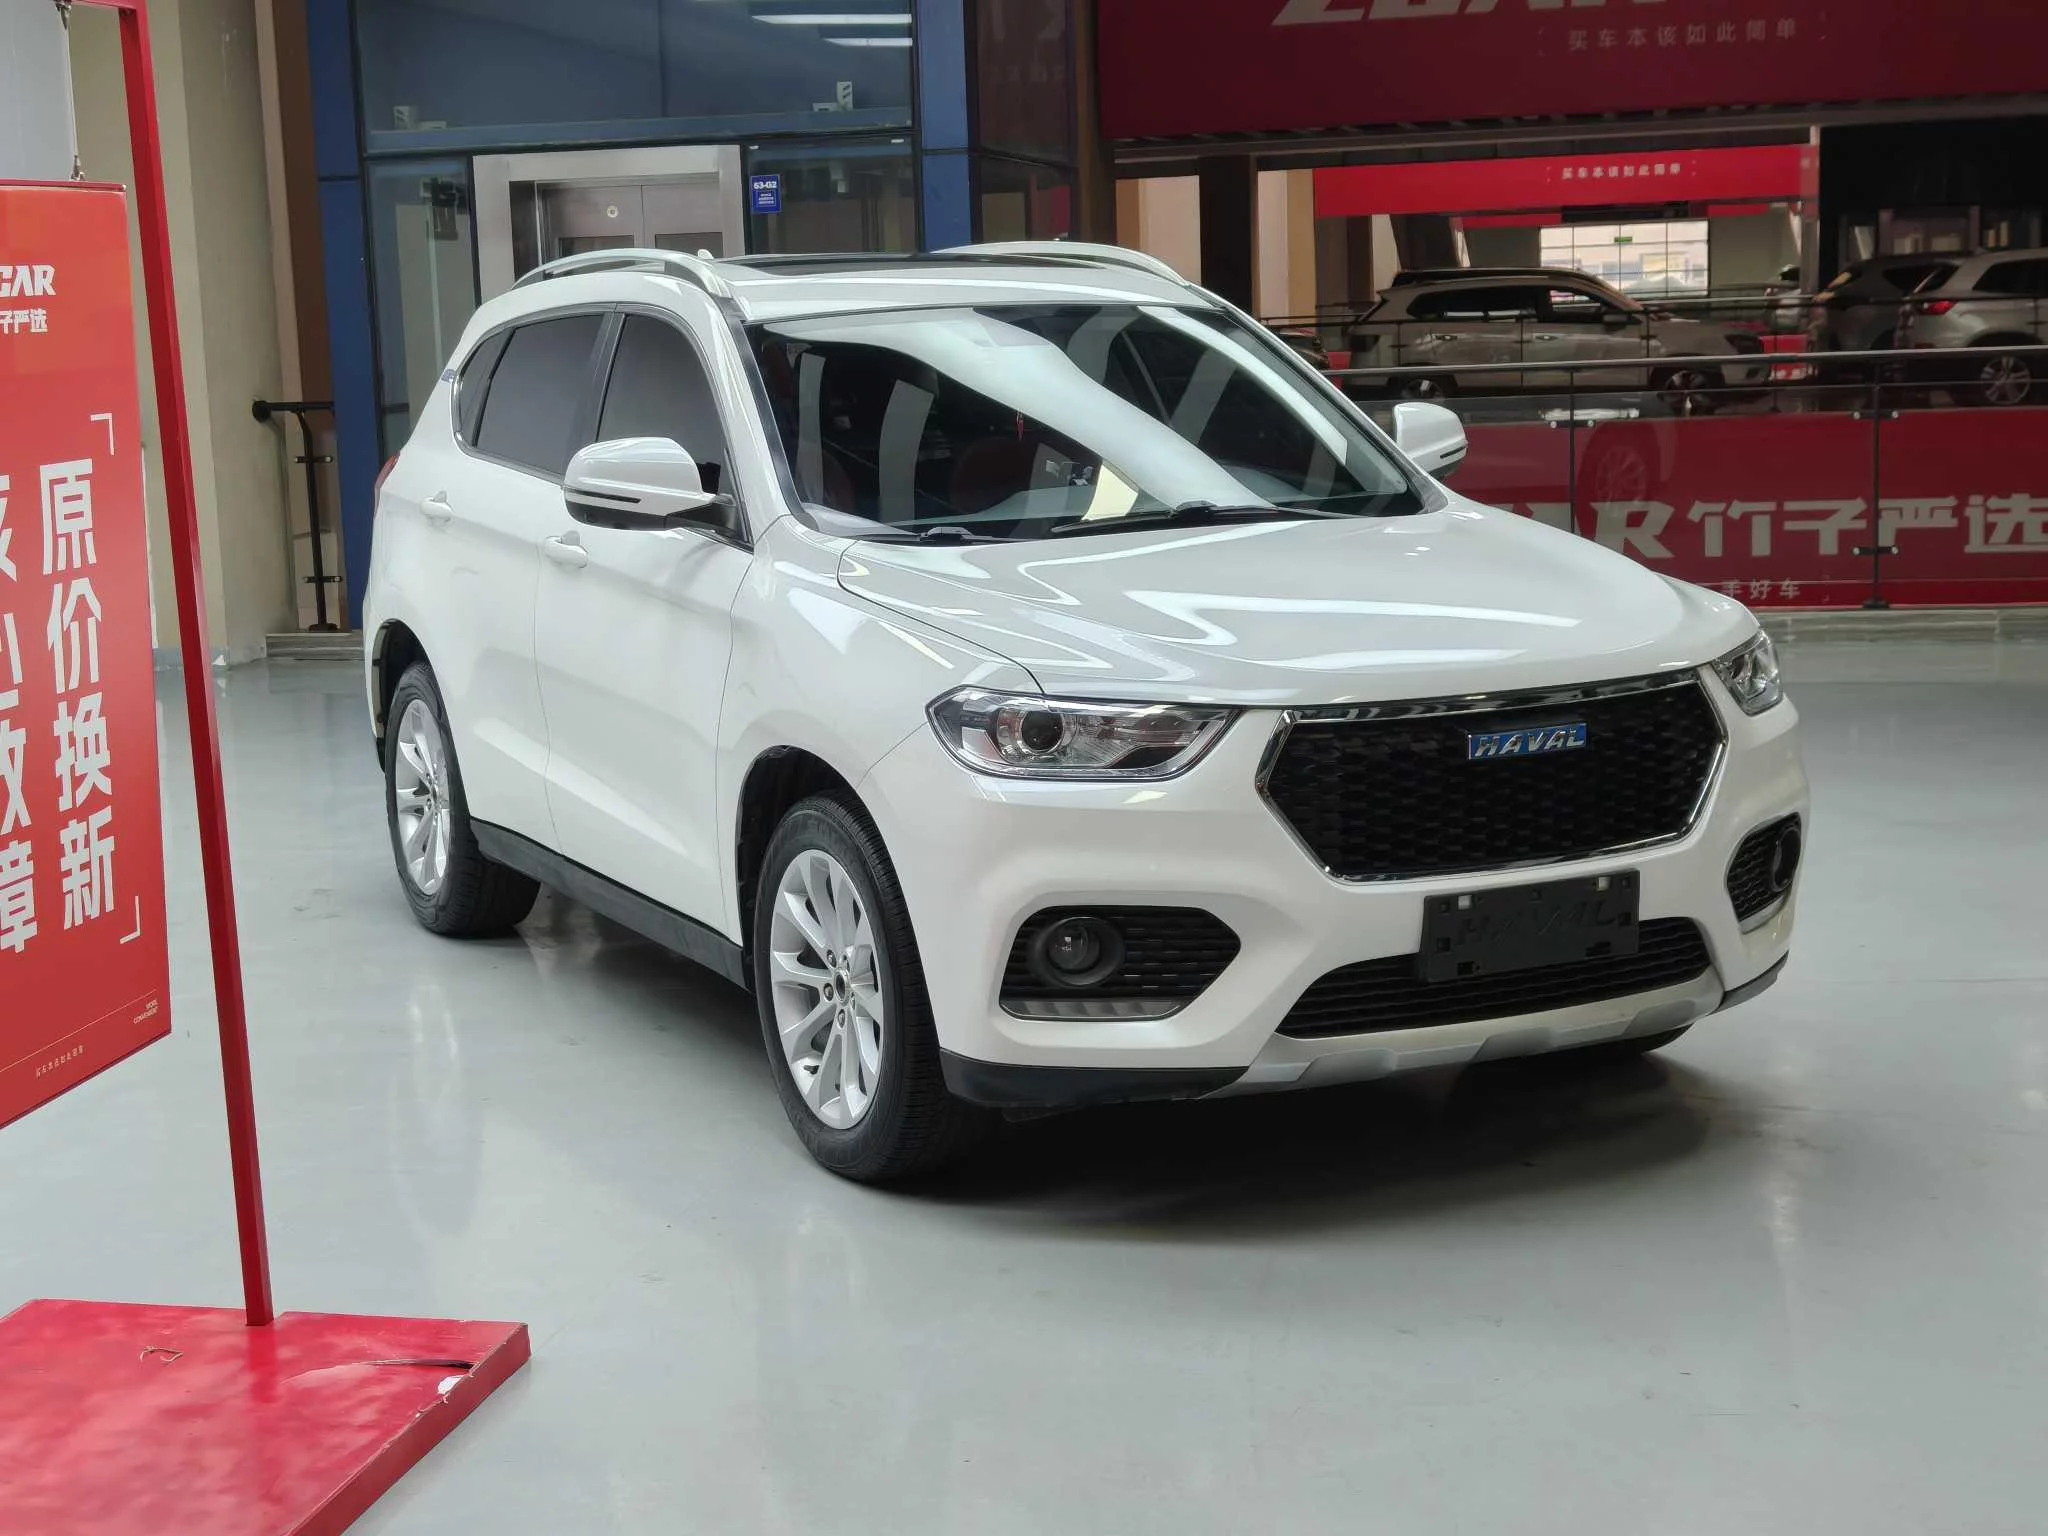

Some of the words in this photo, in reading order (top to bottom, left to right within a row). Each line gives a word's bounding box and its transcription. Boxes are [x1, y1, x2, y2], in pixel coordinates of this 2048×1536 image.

[1569, 18, 1797, 51] 买车本该如此简单
[40, 458, 115, 930] 原价换新
[1474, 729, 1585, 757] HAVAL
